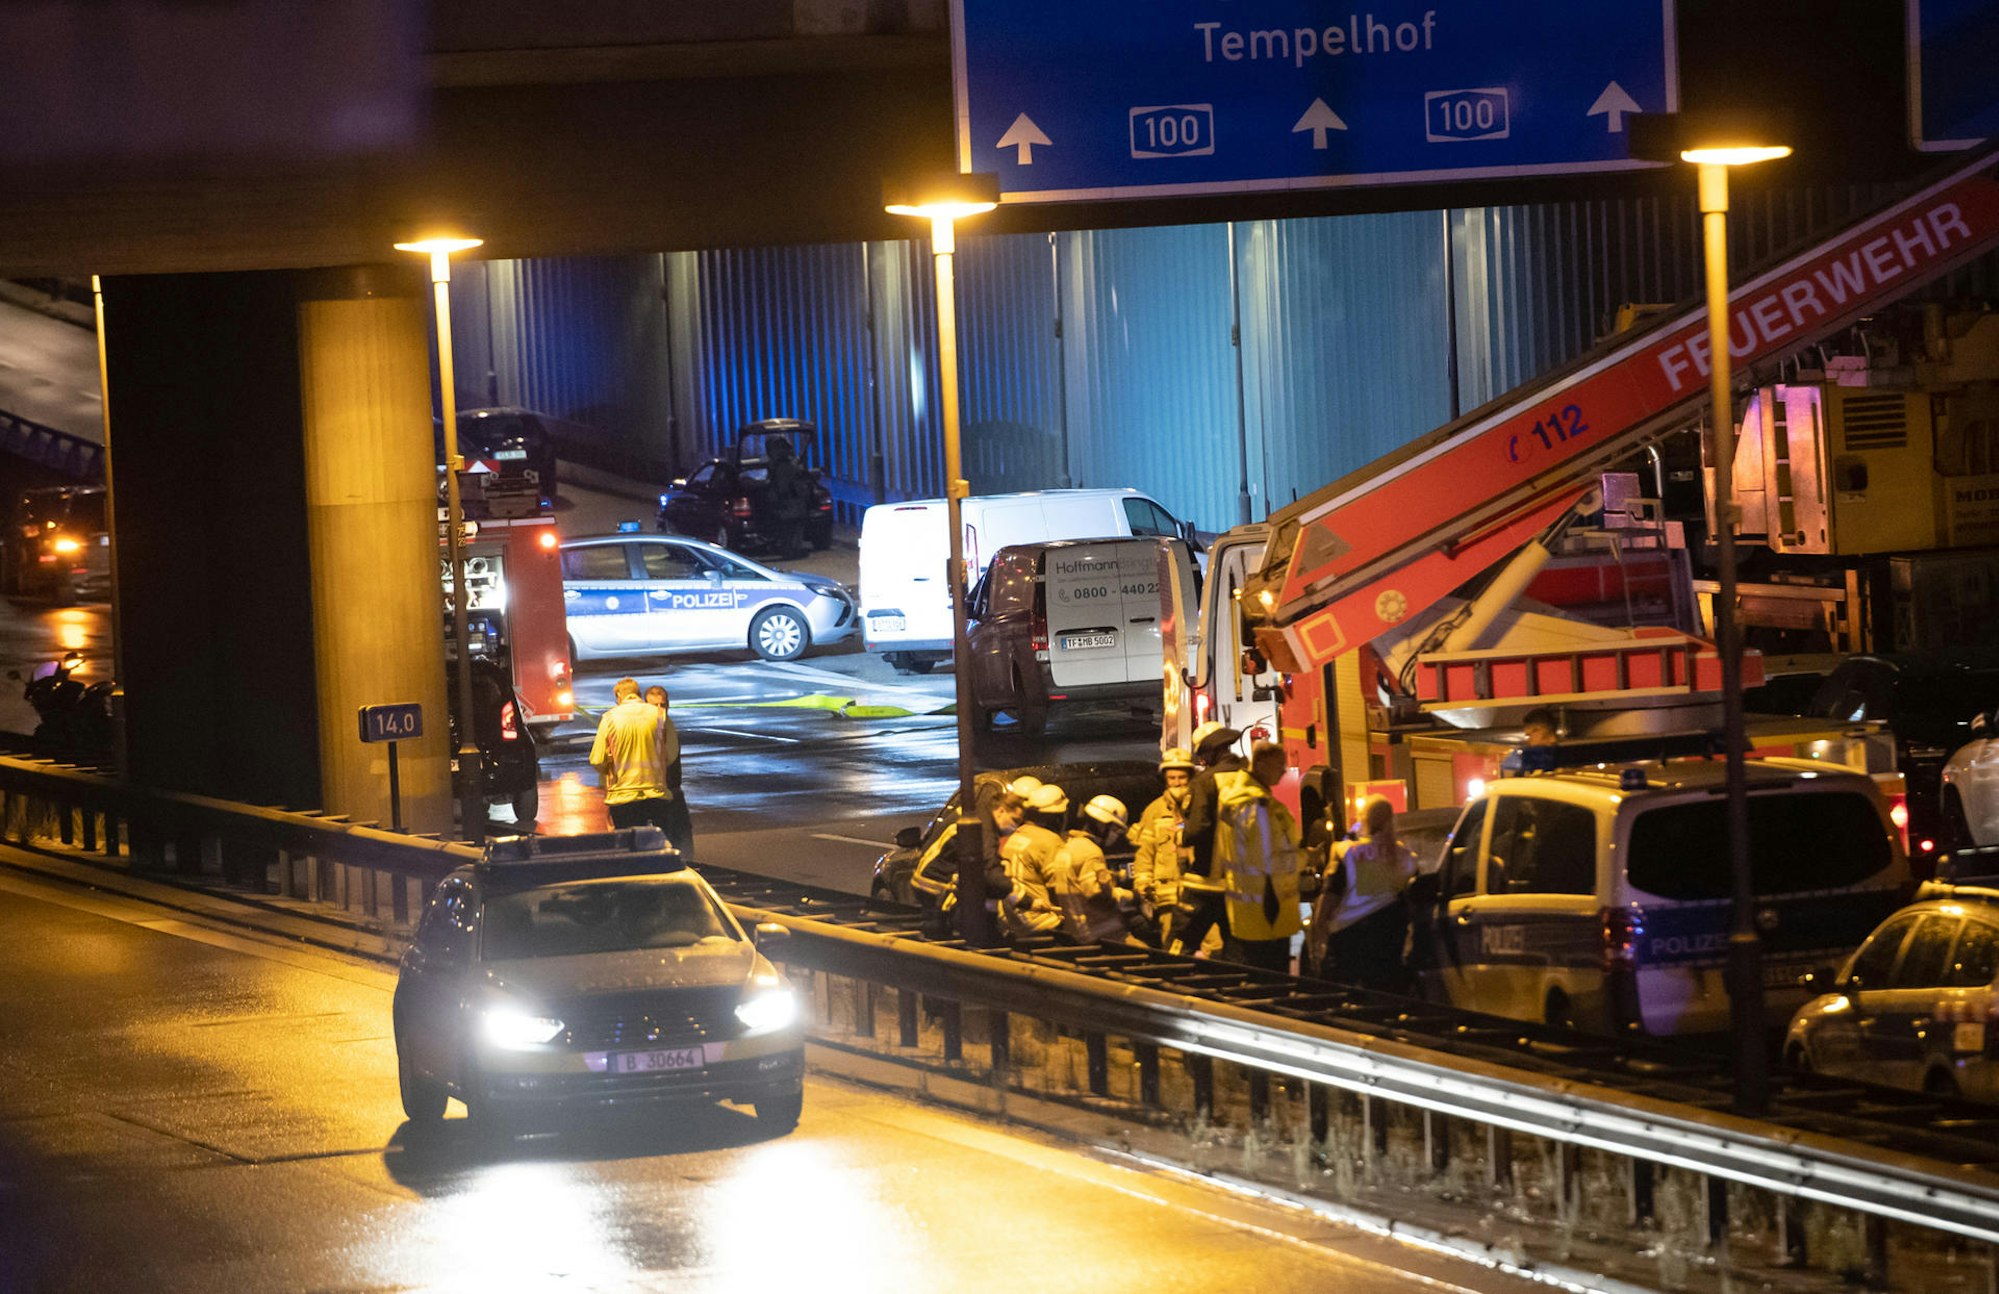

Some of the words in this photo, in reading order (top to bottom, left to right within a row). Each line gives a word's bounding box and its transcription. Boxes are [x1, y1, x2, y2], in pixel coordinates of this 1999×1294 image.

[1194, 10, 1436, 68] Tempelhof
[1441, 99, 1493, 131] 100
[1144, 115, 1199, 147] 100
[1657, 201, 1972, 392] FEUERWEHR
[1531, 404, 1589, 450] 112
[1056, 560, 1119, 574] Hoffmann
[672, 592, 733, 609] POLIZEI
[1074, 586, 1107, 600] 0800
[1121, 583, 1145, 595] 440
[1651, 933, 1729, 956] POLIZE
[627, 1058, 636, 1070] B
[649, 1050, 695, 1068] 30664
